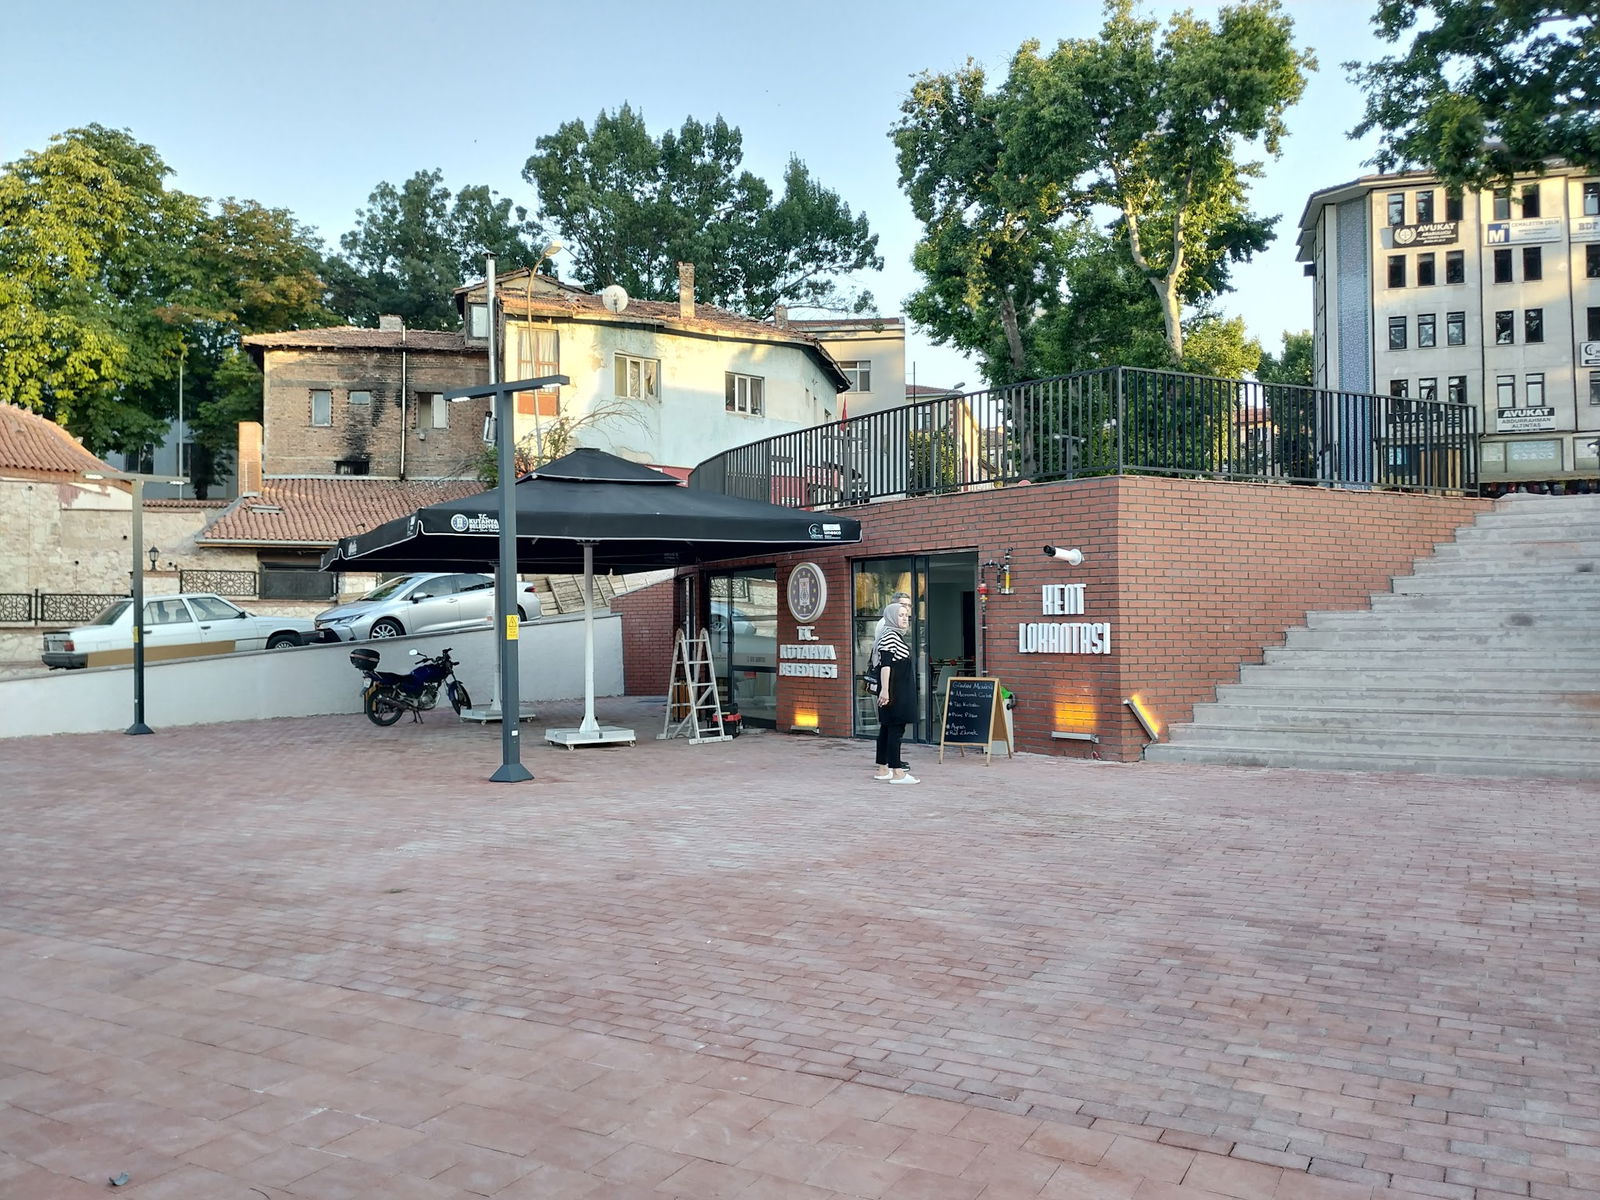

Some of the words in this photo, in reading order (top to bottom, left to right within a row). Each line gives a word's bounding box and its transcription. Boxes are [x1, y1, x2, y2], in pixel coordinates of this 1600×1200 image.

[1417, 222, 1456, 232] AVUKAT
[1503, 409, 1550, 417] AVUKAT
[1042, 583, 1087, 615] KENT
[1019, 622, 1111, 654] LOKANTASI
